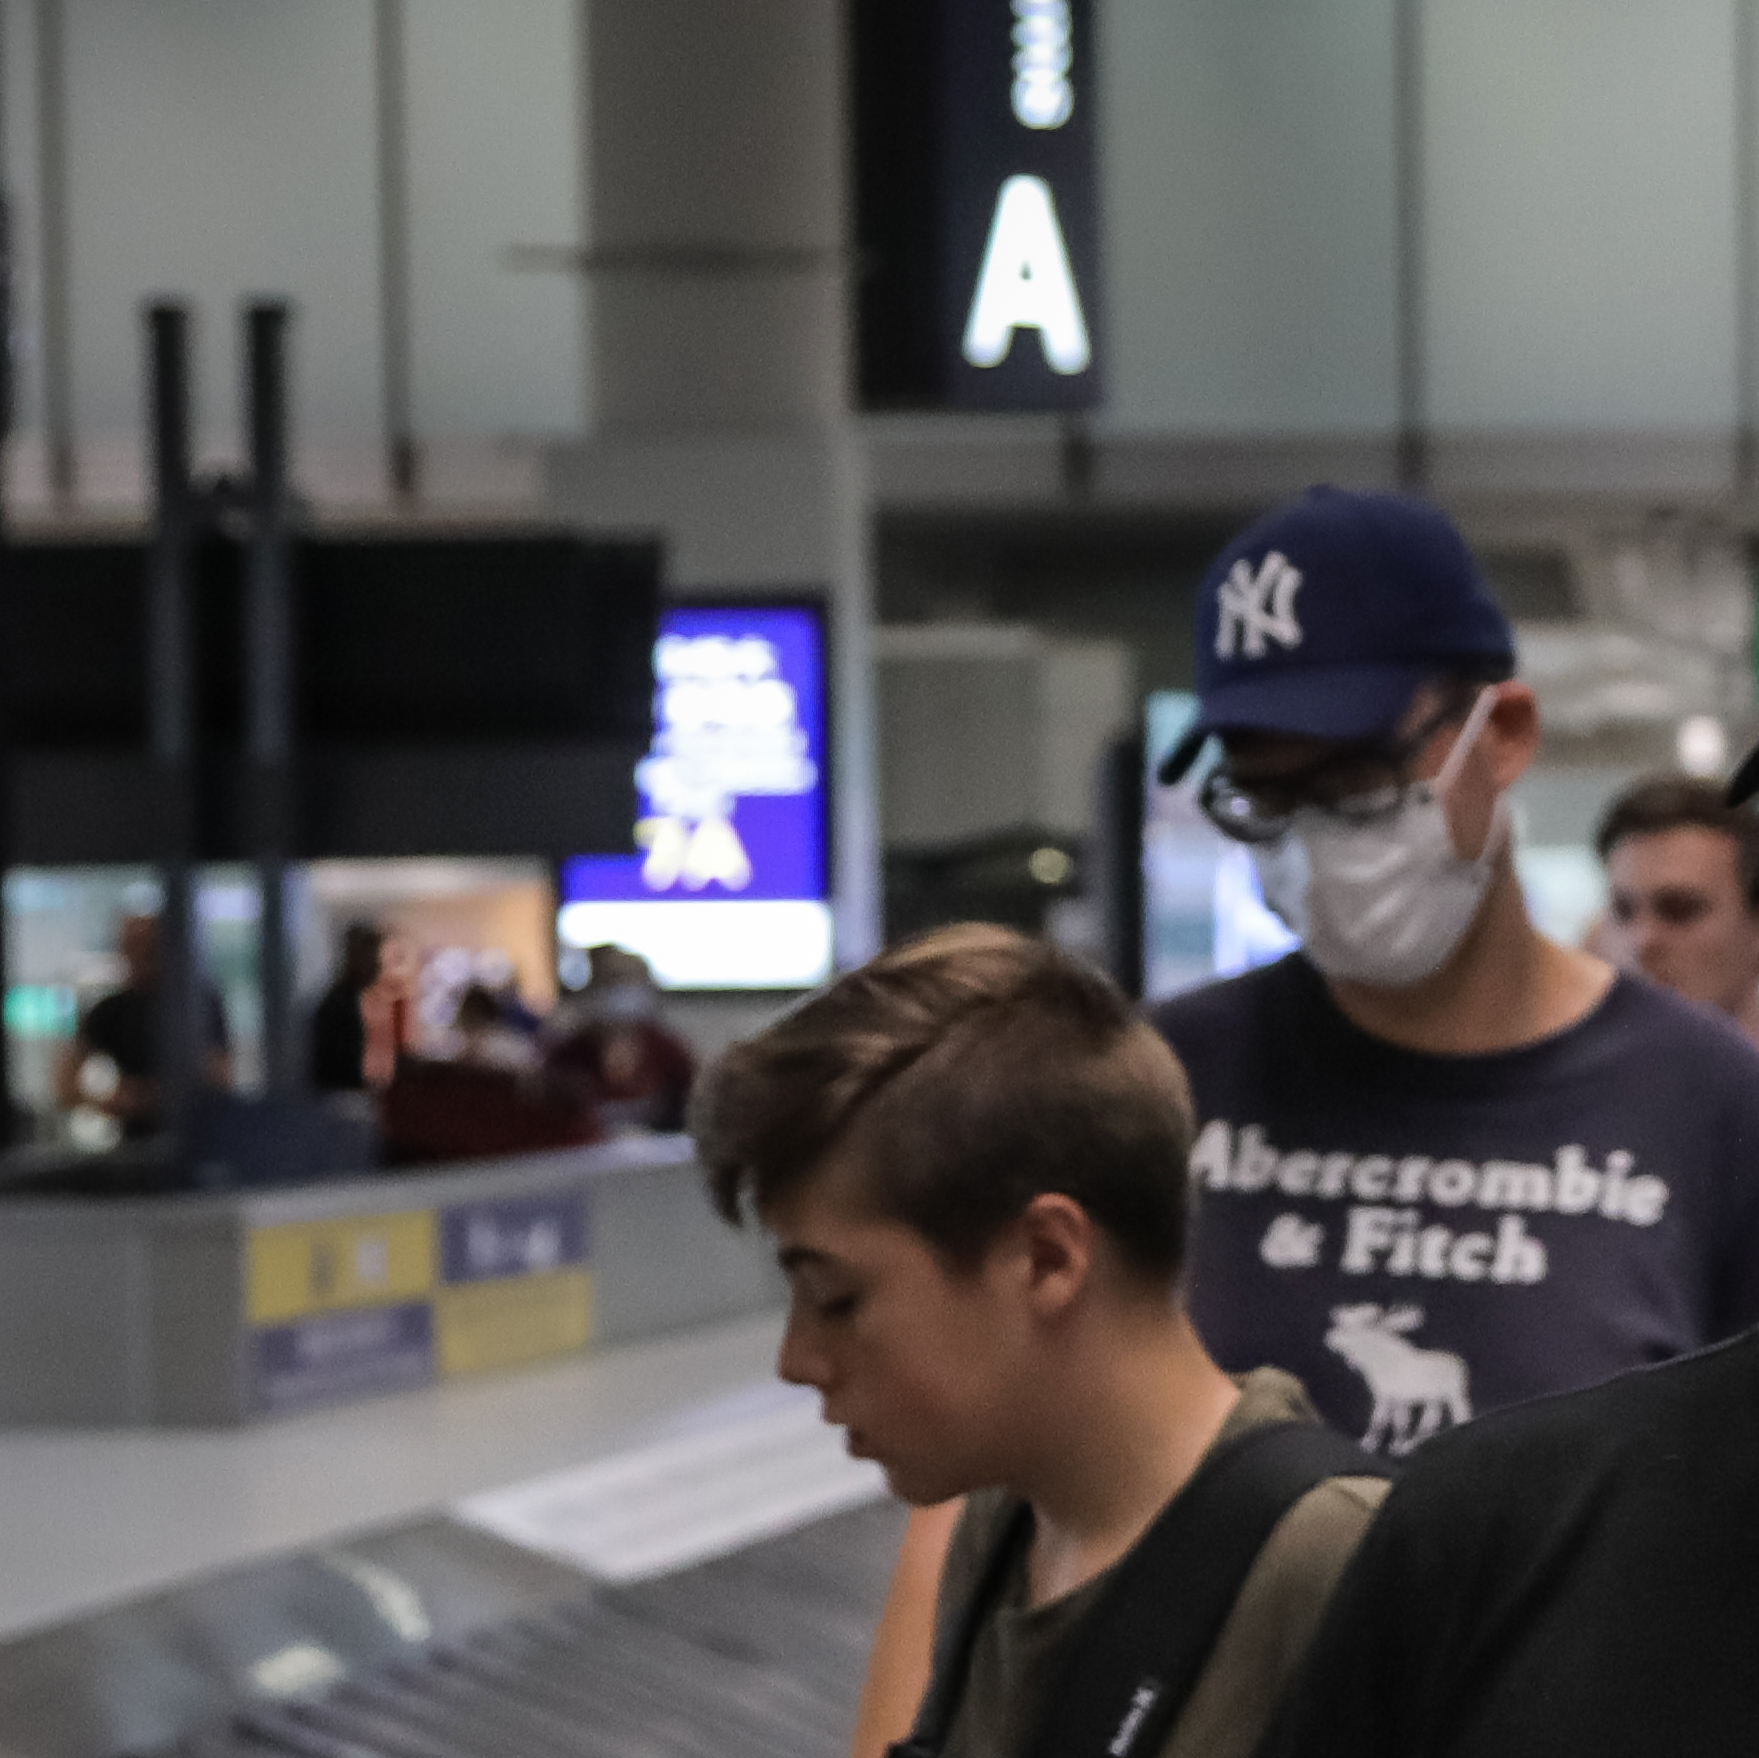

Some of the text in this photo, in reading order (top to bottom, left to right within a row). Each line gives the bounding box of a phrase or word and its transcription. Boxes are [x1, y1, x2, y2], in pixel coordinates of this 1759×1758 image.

[962, 172, 1091, 375] A
[1216, 551, 1303, 661] NY
[1187, 1118, 1670, 1227] Abercrombie
[1260, 1206, 1549, 1285] & Fitch
